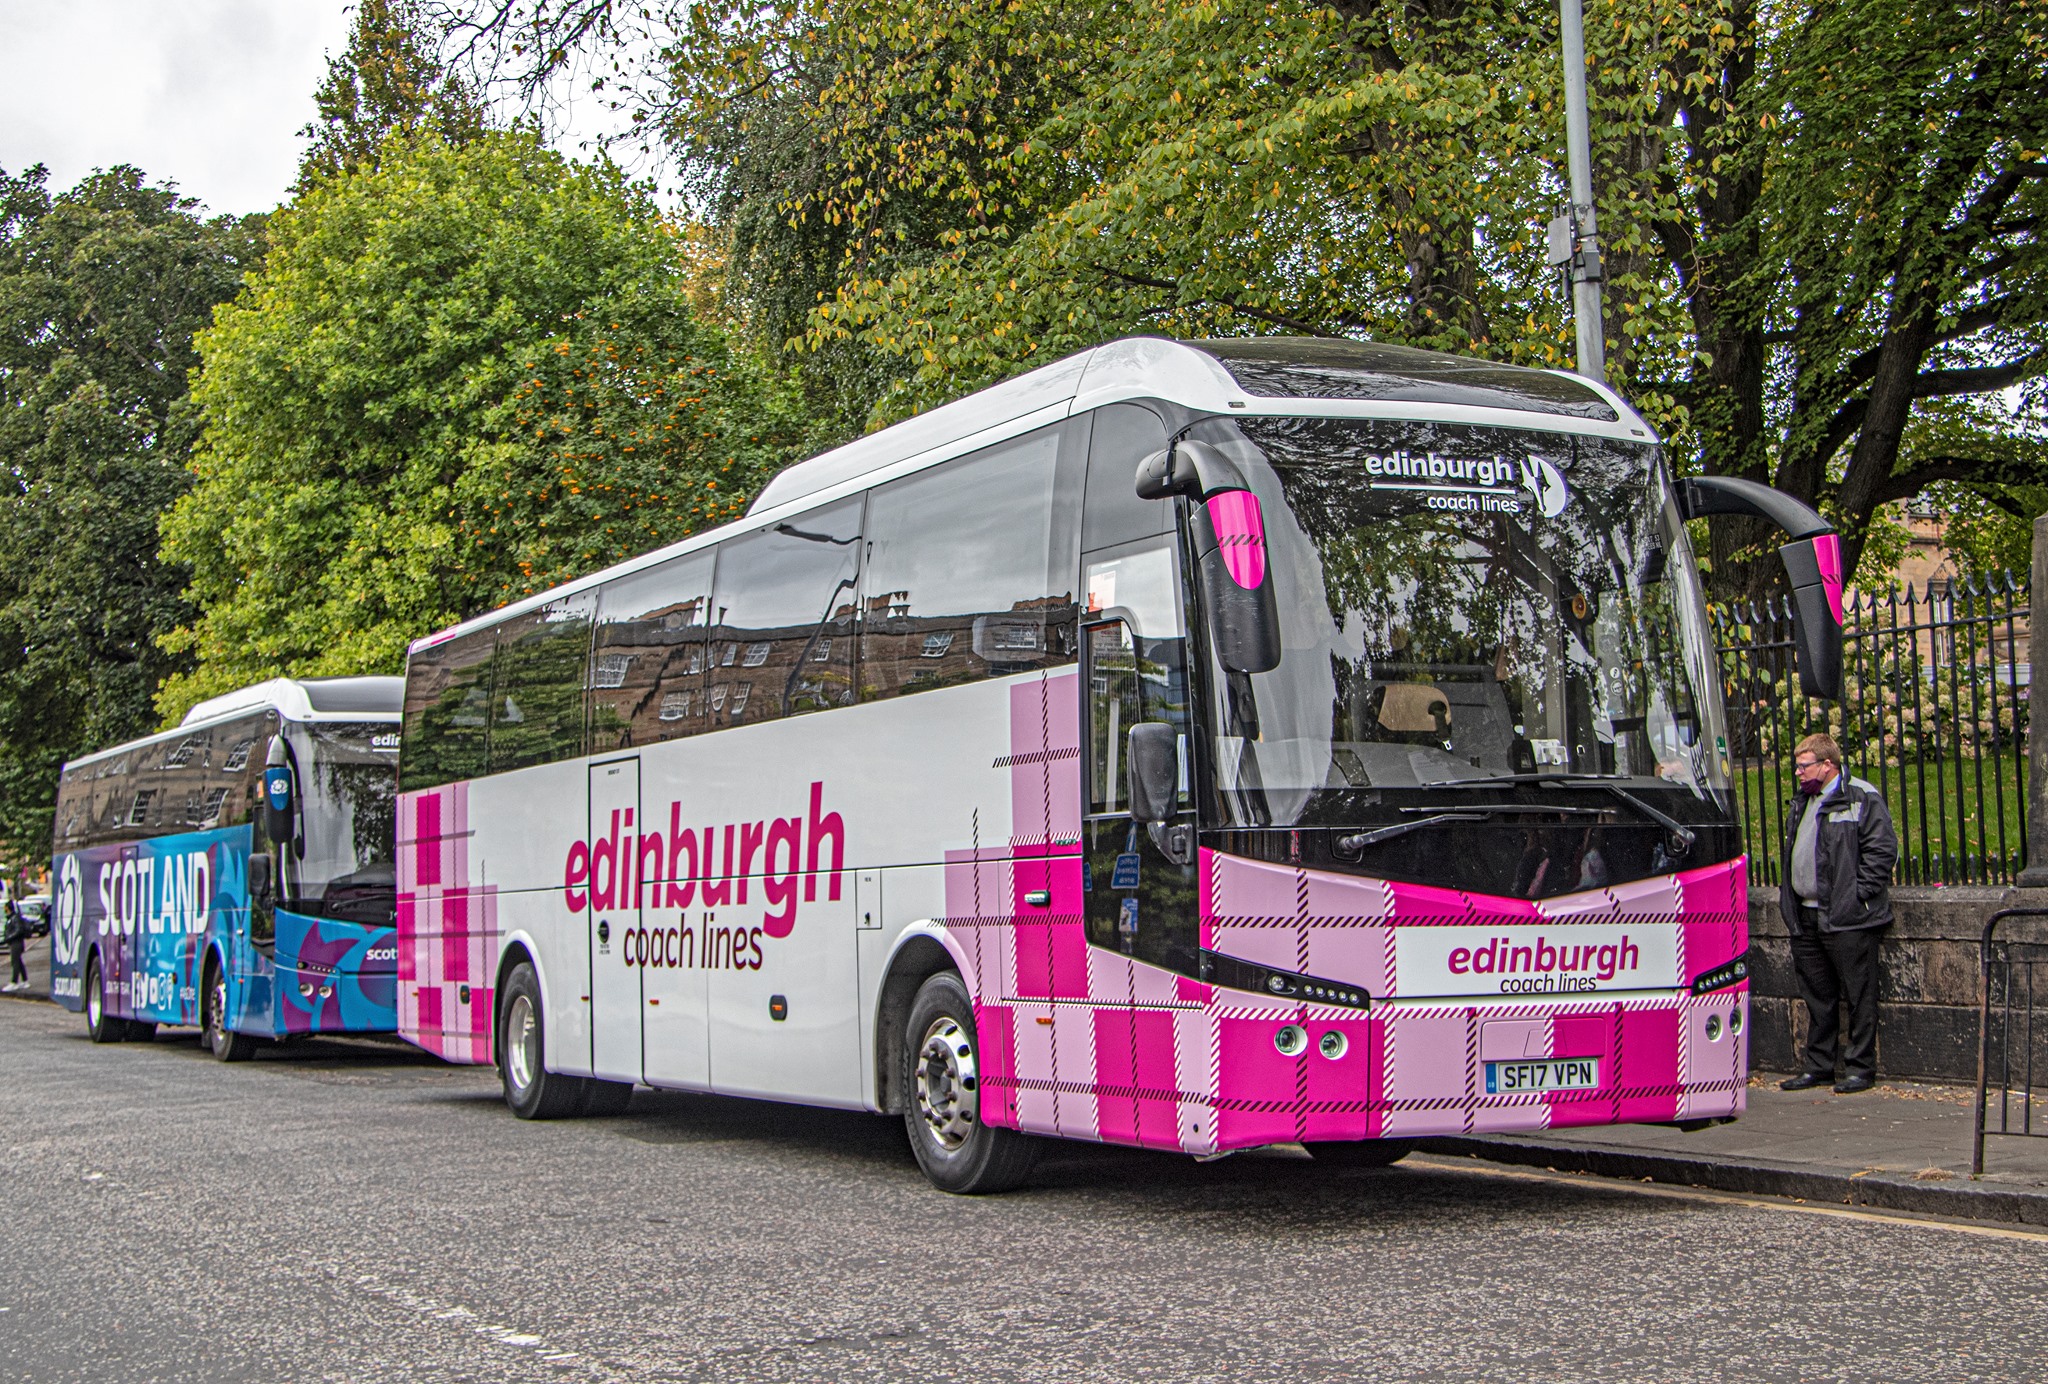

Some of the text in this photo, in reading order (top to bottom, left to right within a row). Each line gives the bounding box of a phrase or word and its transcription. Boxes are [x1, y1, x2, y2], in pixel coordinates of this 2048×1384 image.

[1364, 451, 1515, 486] edinburgh
[1427, 494, 1520, 513] coach lines
[564, 781, 845, 938] edinburgh
[98, 851, 210, 937] SCOTLAND
[624, 912, 763, 970] coach lines
[1448, 935, 1639, 980] edinburgh
[1500, 974, 1597, 993] coach lines
[1504, 1062, 1592, 1088] SF17 VPN
